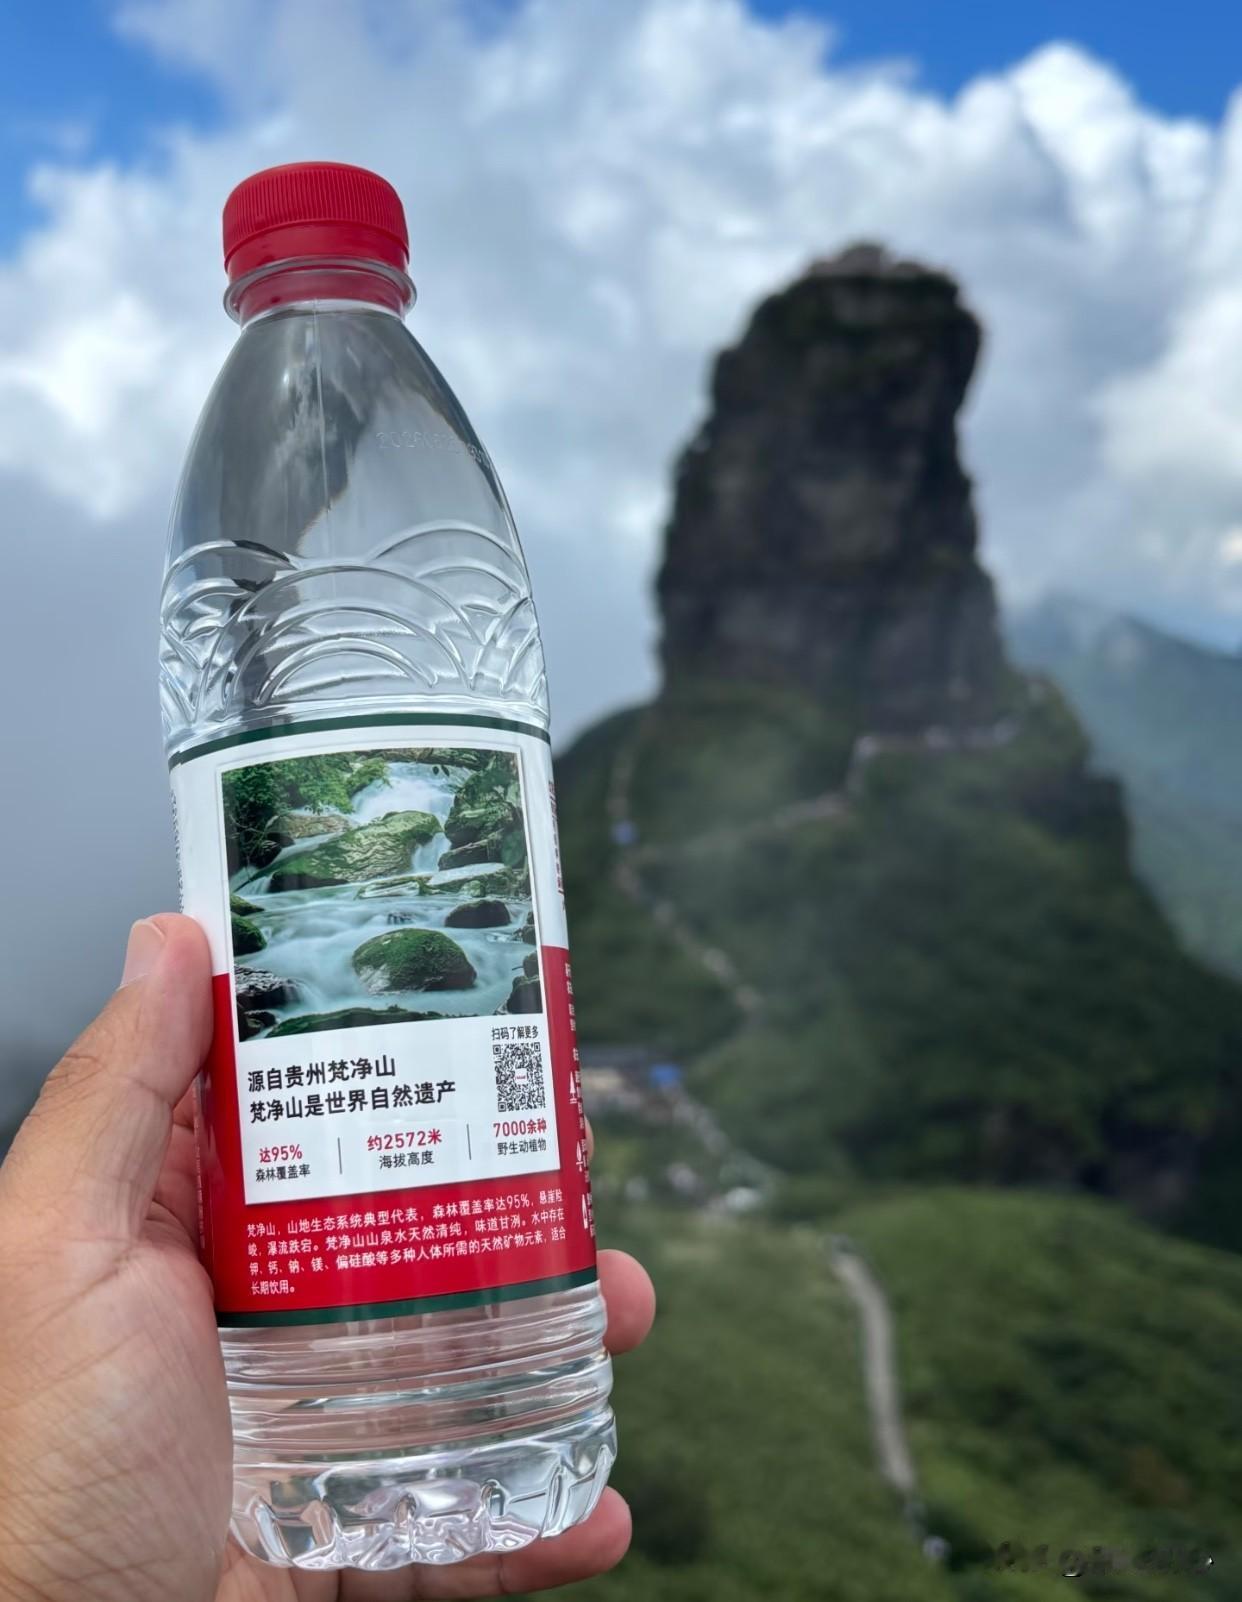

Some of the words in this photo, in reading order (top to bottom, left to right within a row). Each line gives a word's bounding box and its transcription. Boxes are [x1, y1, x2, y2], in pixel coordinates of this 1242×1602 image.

[491, 1025, 539, 1041] 扫码了解更多
[247, 1054, 396, 1093] 源自贵州梵净山
[250, 1079, 456, 1123] 梵净山是世界自然遗产
[493, 1117, 547, 1137] 7000余种
[367, 1128, 442, 1151] 约2572米
[497, 1138, 546, 1156] 野生动植物
[259, 1143, 303, 1164] 达95%
[379, 1150, 435, 1170] 海拔高度
[255, 1163, 311, 1183] 森林覆盖率
